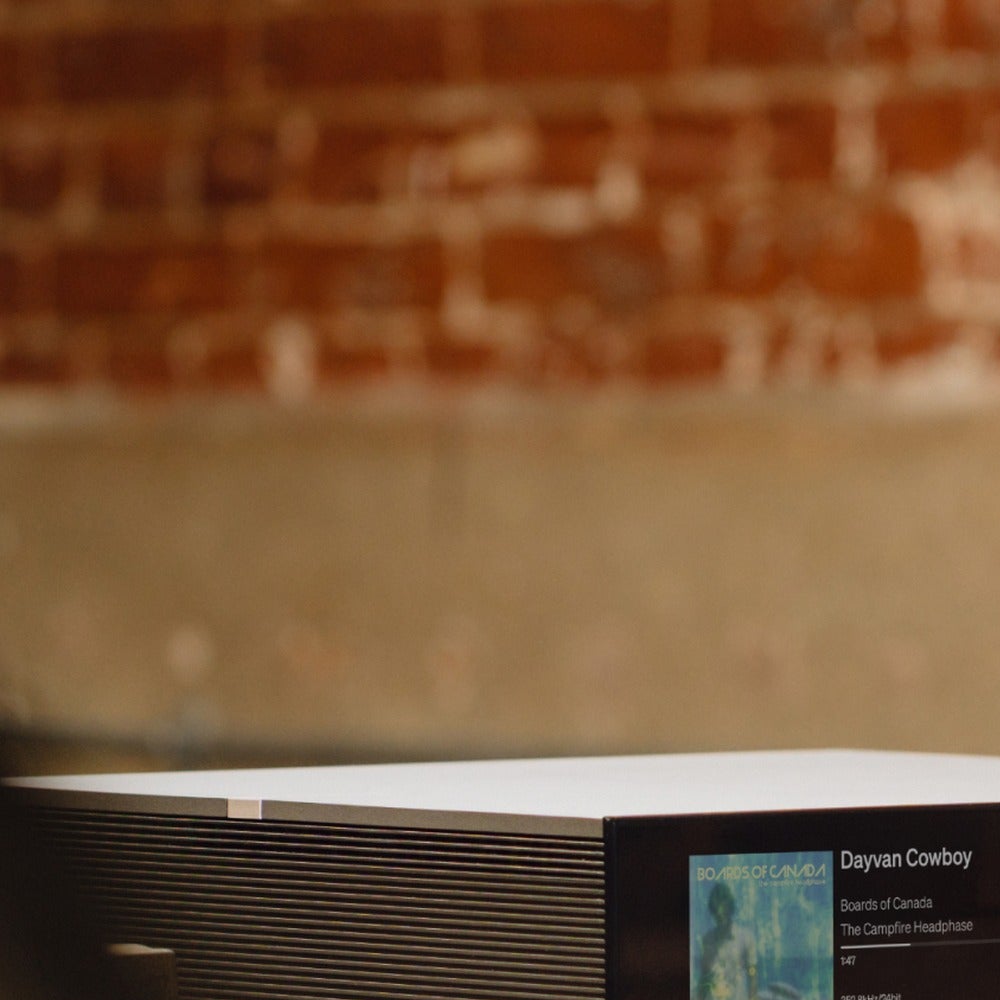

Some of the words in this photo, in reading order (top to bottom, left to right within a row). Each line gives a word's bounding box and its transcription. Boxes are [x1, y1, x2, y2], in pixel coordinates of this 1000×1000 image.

[840, 849, 902, 873] Dayvan
[906, 847, 973, 870] Cowboy
[697, 865, 750, 881] BOARDS
[751, 864, 767, 879] OF
[769, 863, 827, 879] CANADA
[840, 898, 878, 912] Boards
[880, 897, 891, 911] of
[893, 896, 933, 910] Canada
[840, 923, 861, 937] The
[863, 921, 912, 937] Campfire
[913, 919, 974, 935] Headphase
